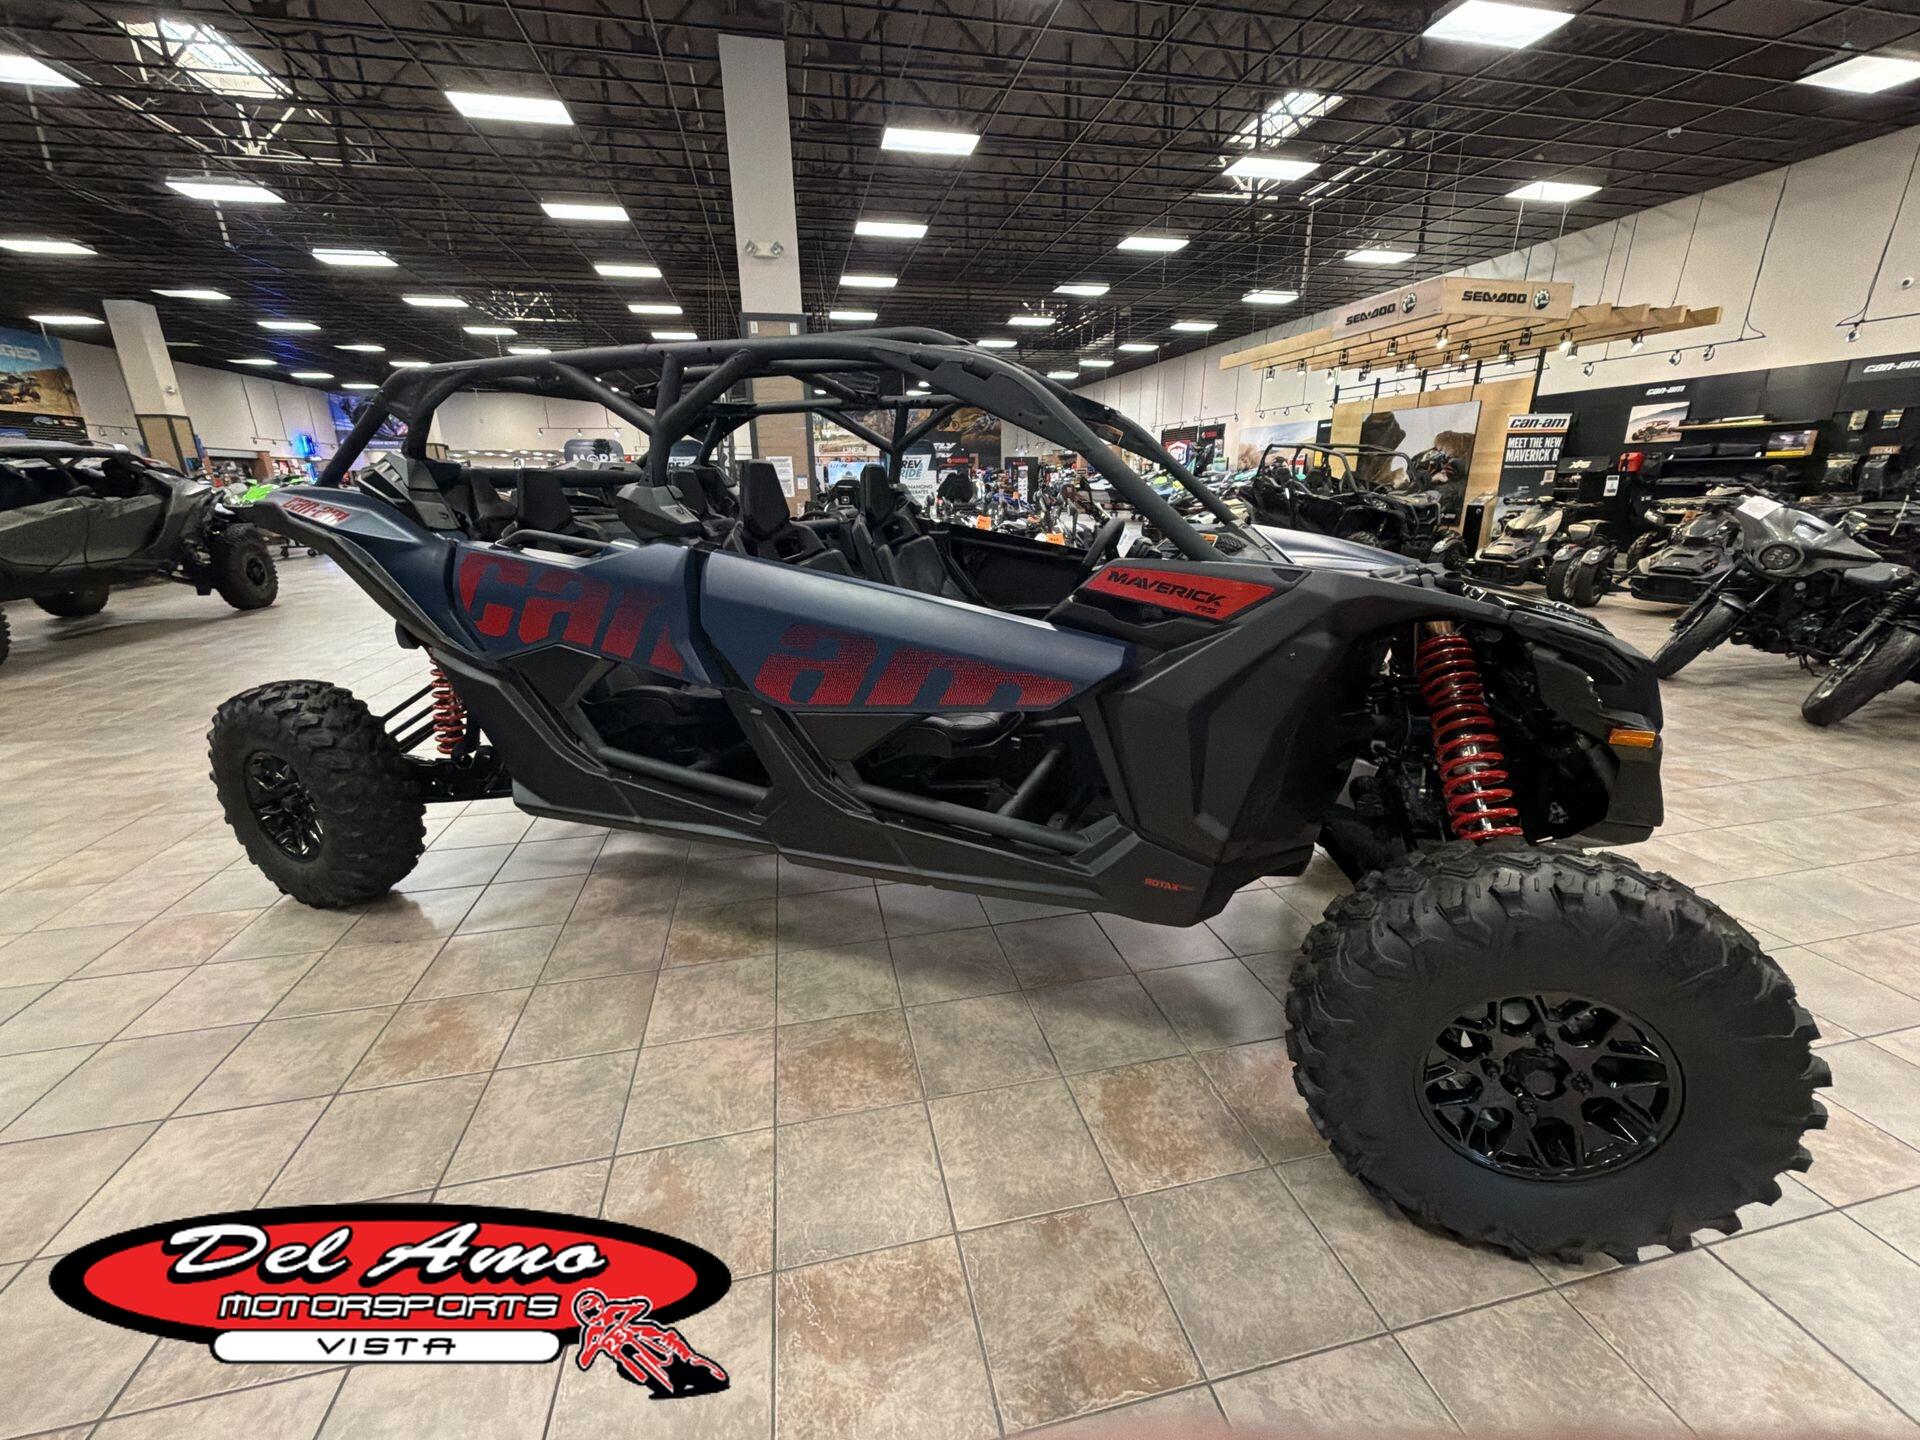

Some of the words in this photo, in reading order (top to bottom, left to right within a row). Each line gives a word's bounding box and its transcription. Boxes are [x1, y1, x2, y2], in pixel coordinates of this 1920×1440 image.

[1510, 418, 1567, 428] can-am
[1507, 437, 1529, 448] MEET
[1530, 437, 1544, 448] THE
[1544, 437, 1563, 448] NEW
[1505, 449, 1551, 462] MAVERICK
[1551, 449, 1560, 461] R
[1107, 570, 1226, 607] MAVERICK
